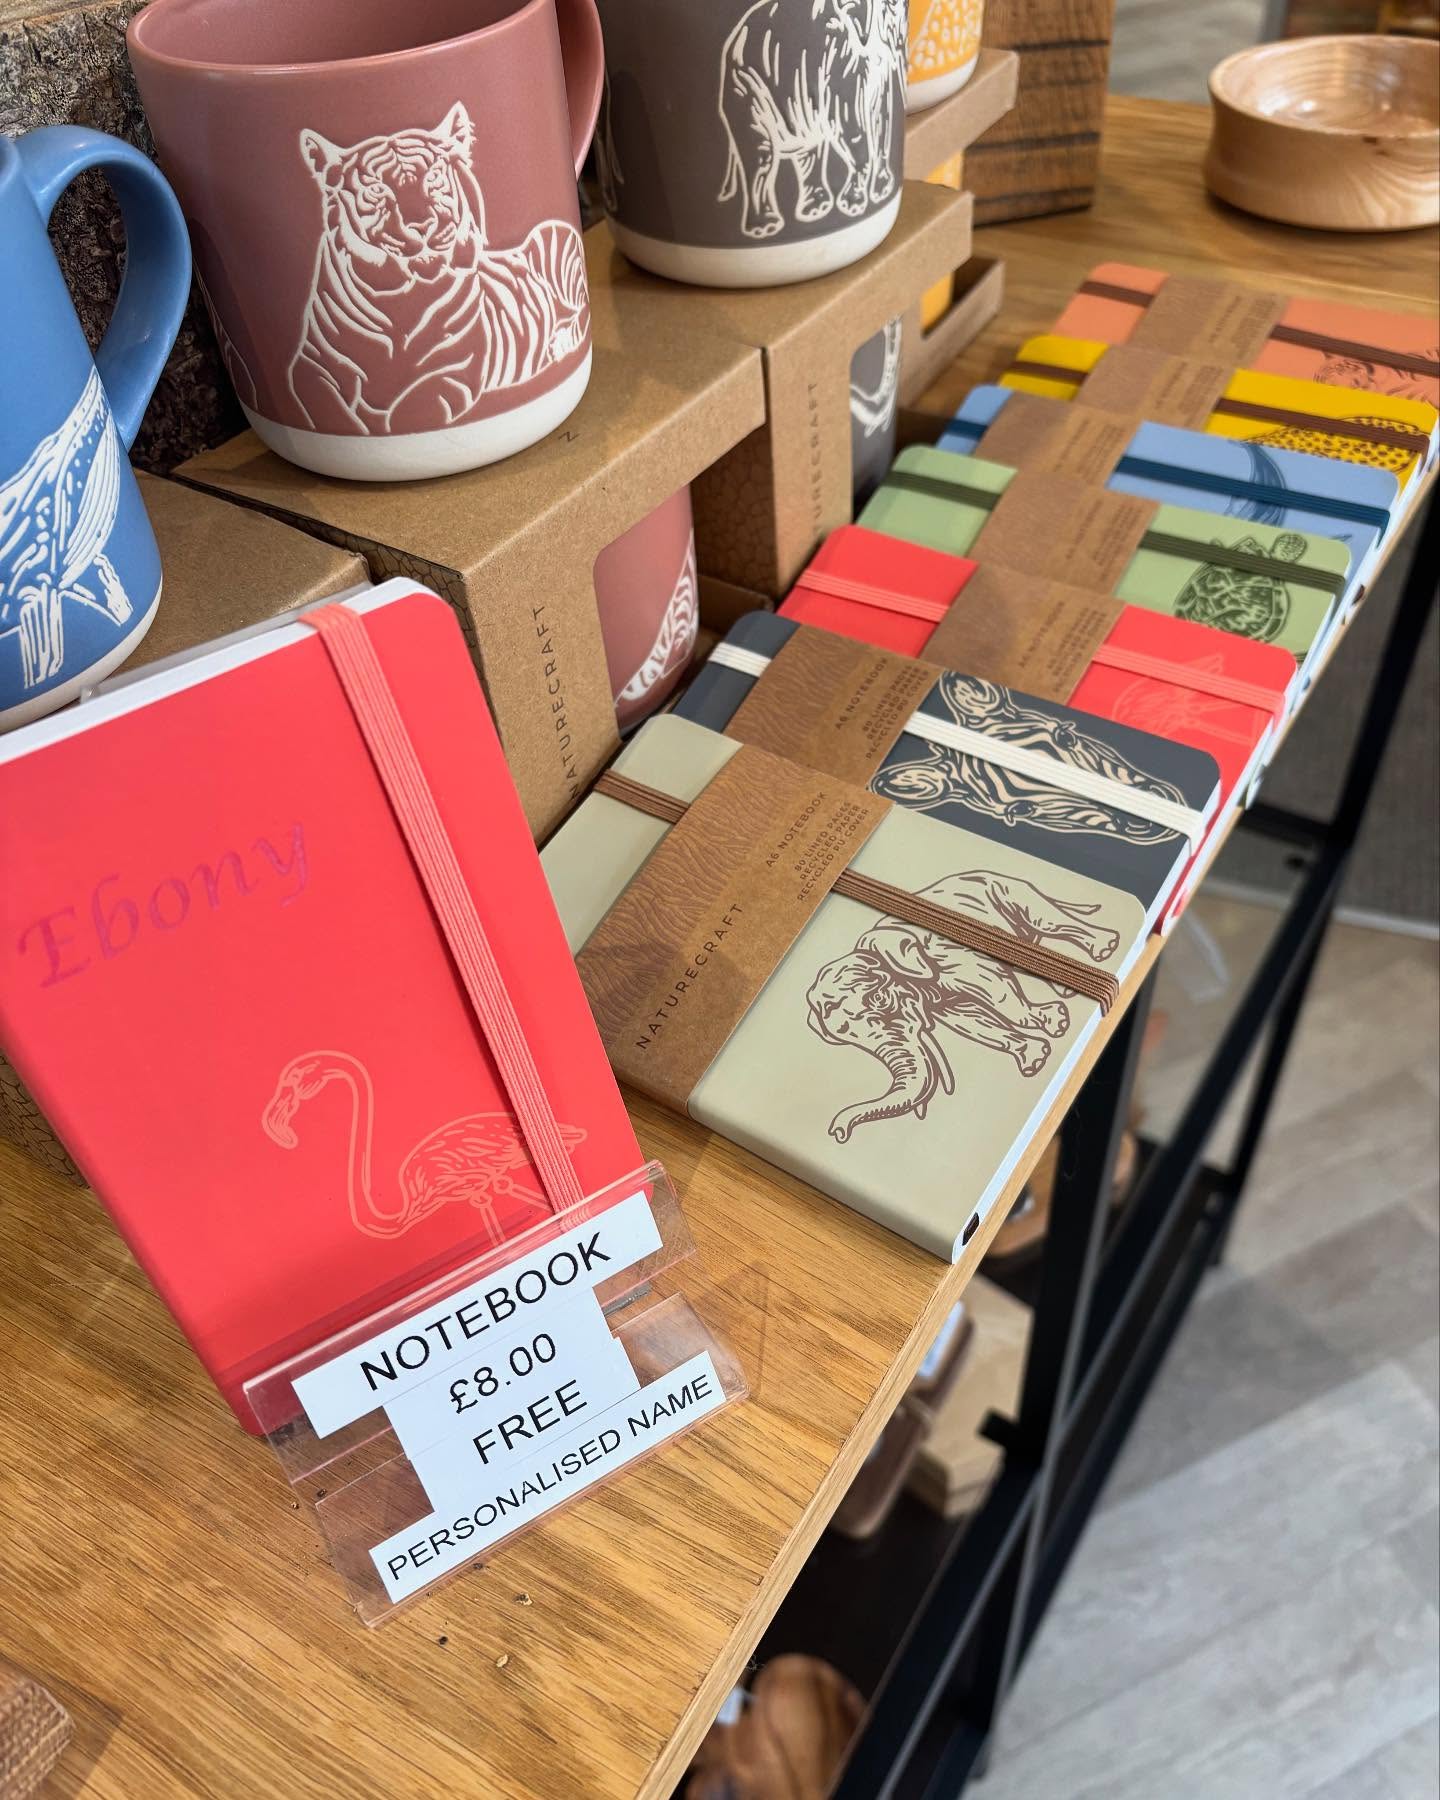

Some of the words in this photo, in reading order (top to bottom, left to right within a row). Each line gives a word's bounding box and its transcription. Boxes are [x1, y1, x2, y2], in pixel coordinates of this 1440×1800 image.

[533, 605, 580, 800] NATURECRAFT
[845, 657, 887, 712] NOTEBOOK
[766, 853, 780, 868] A6
[777, 792, 828, 850] NOTEBOOK
[794, 859, 806, 872] 80
[804, 831, 828, 858] LINED
[827, 802, 851, 829] PAGES
[797, 854, 834, 901] RECYCLED
[833, 839, 846, 852] PU
[844, 808, 869, 837] COVER
[800, 835, 837, 880] RECYCLED
[836, 805, 860, 832] PAPER
[18, 821, 307, 988] Ebony
[636, 904, 743, 1049] NATURECRAFT
[359, 1232, 611, 1391] NOTEBOOK
[450, 1333, 556, 1414] £8.00
[472, 1379, 588, 1464] FREE
[387, 1429, 621, 1580] PERSONALISED
[627, 1374, 713, 1437] NAME
